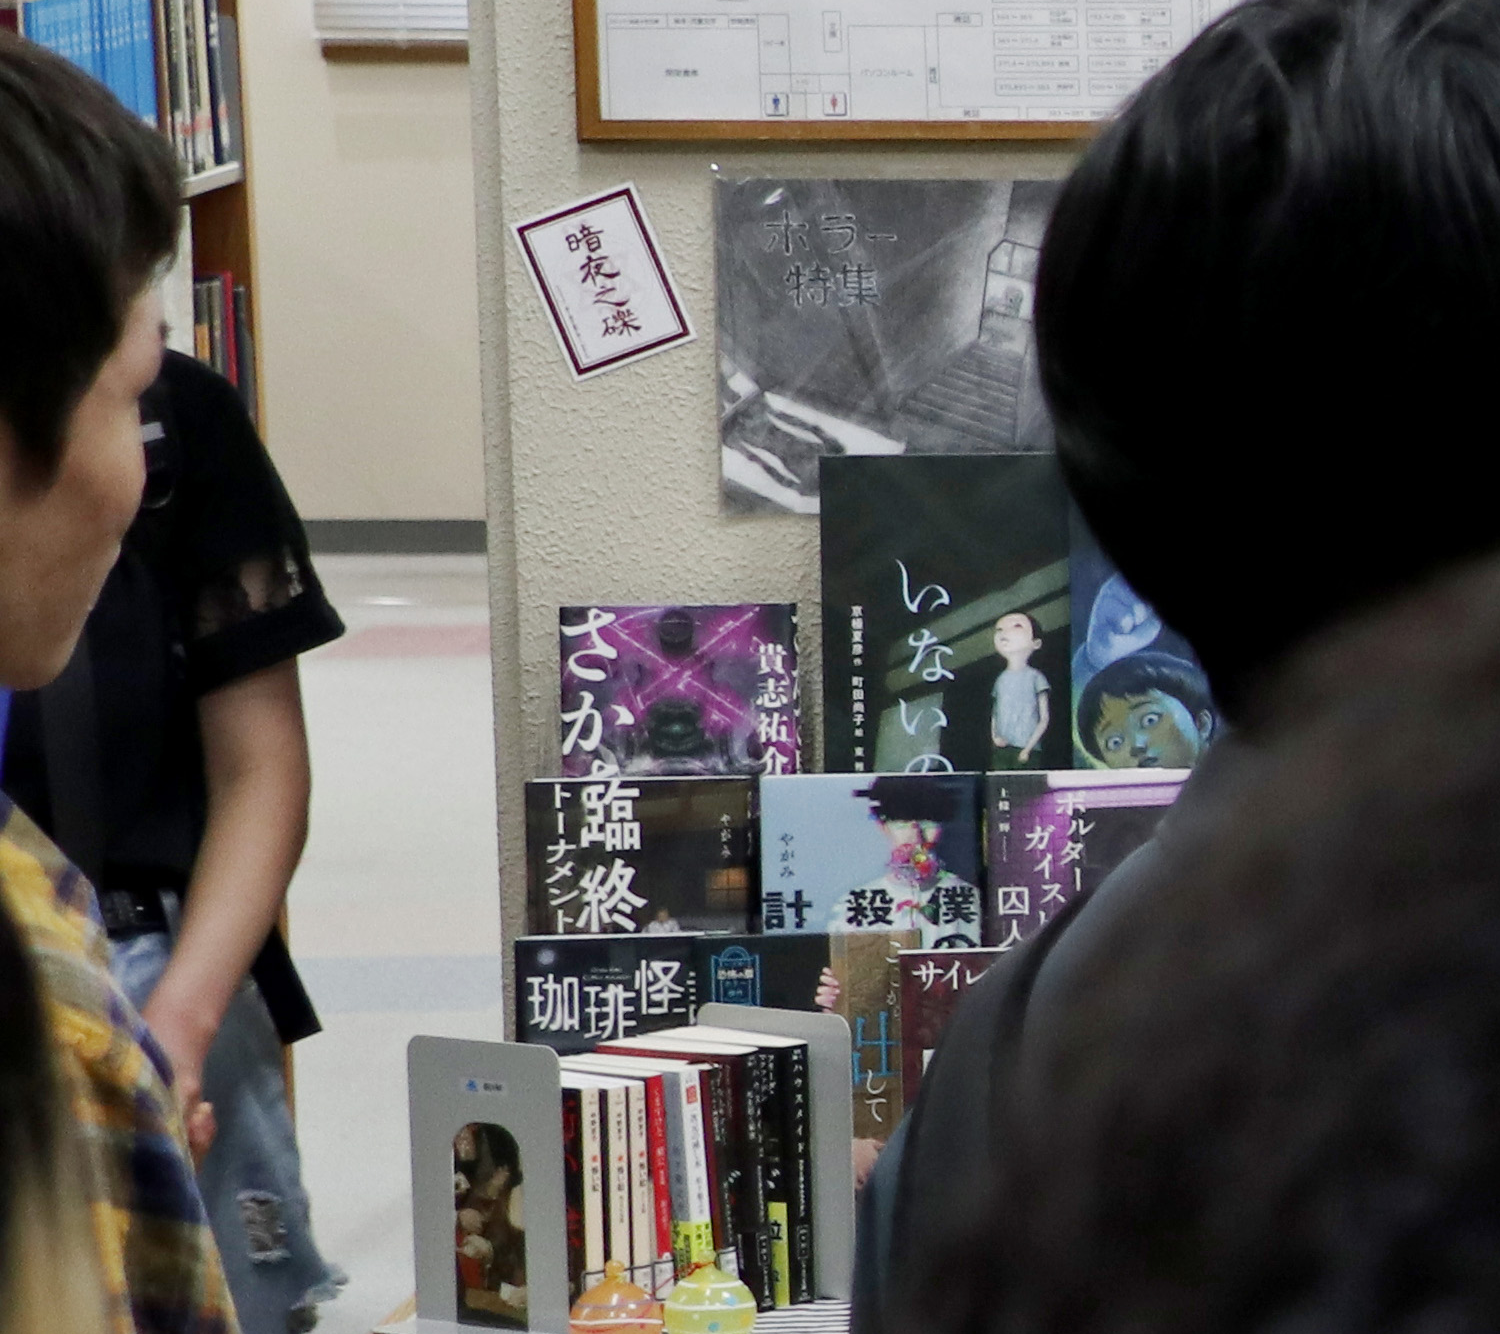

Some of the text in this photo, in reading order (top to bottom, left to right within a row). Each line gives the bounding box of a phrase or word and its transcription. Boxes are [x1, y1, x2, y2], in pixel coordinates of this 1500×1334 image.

[763, 209, 897, 256] ホラー
[783, 261, 881, 308] 特集
[755, 642, 790, 775] 貴志祐介
[545, 783, 580, 934] トーナメント
[575, 781, 649, 933] 臨終
[778, 832, 796, 879] やがみ
[763, 890, 814, 929] 計
[846, 888, 895, 927] 殺
[997, 886, 1030, 947] 囚人
